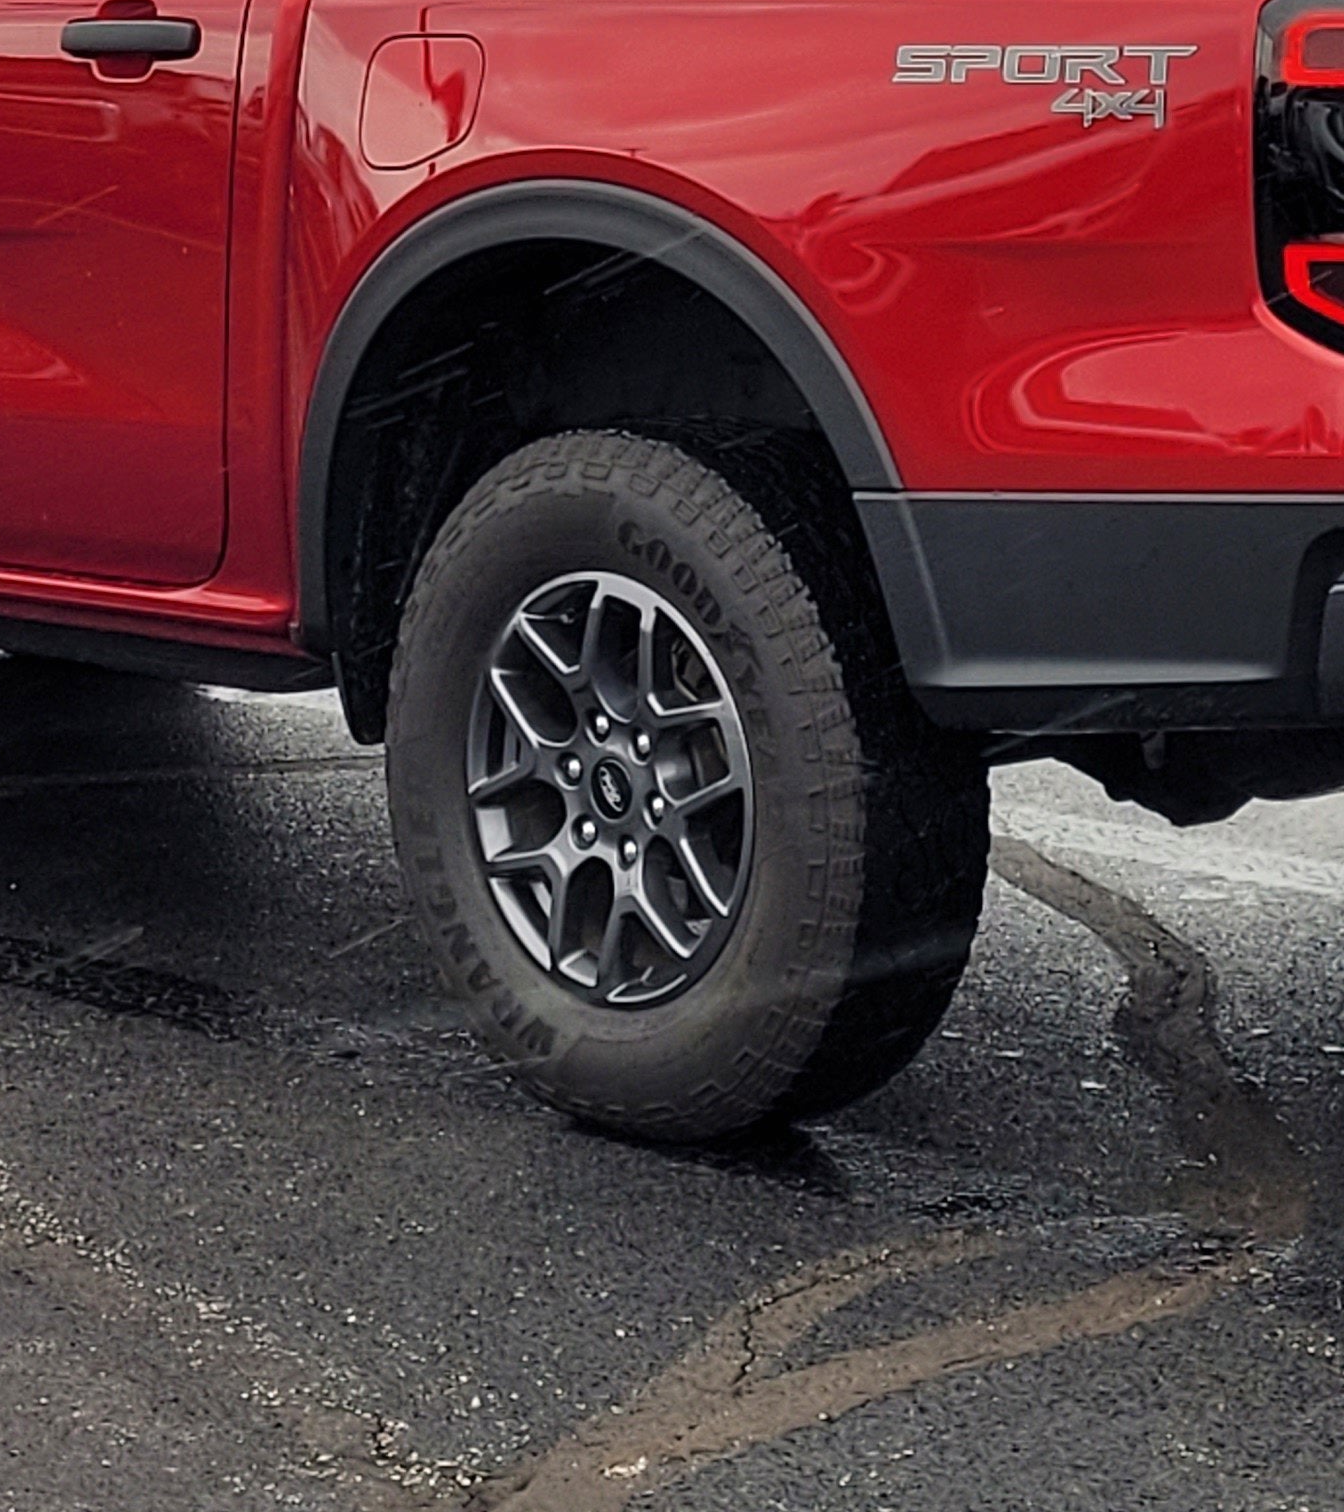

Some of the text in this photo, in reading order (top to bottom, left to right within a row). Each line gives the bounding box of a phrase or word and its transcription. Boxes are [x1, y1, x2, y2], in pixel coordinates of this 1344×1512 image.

[891, 43, 1199, 86] SPORT
[617, 519, 773, 778] GOODYEA
[405, 778, 560, 1057] WRANGLE
